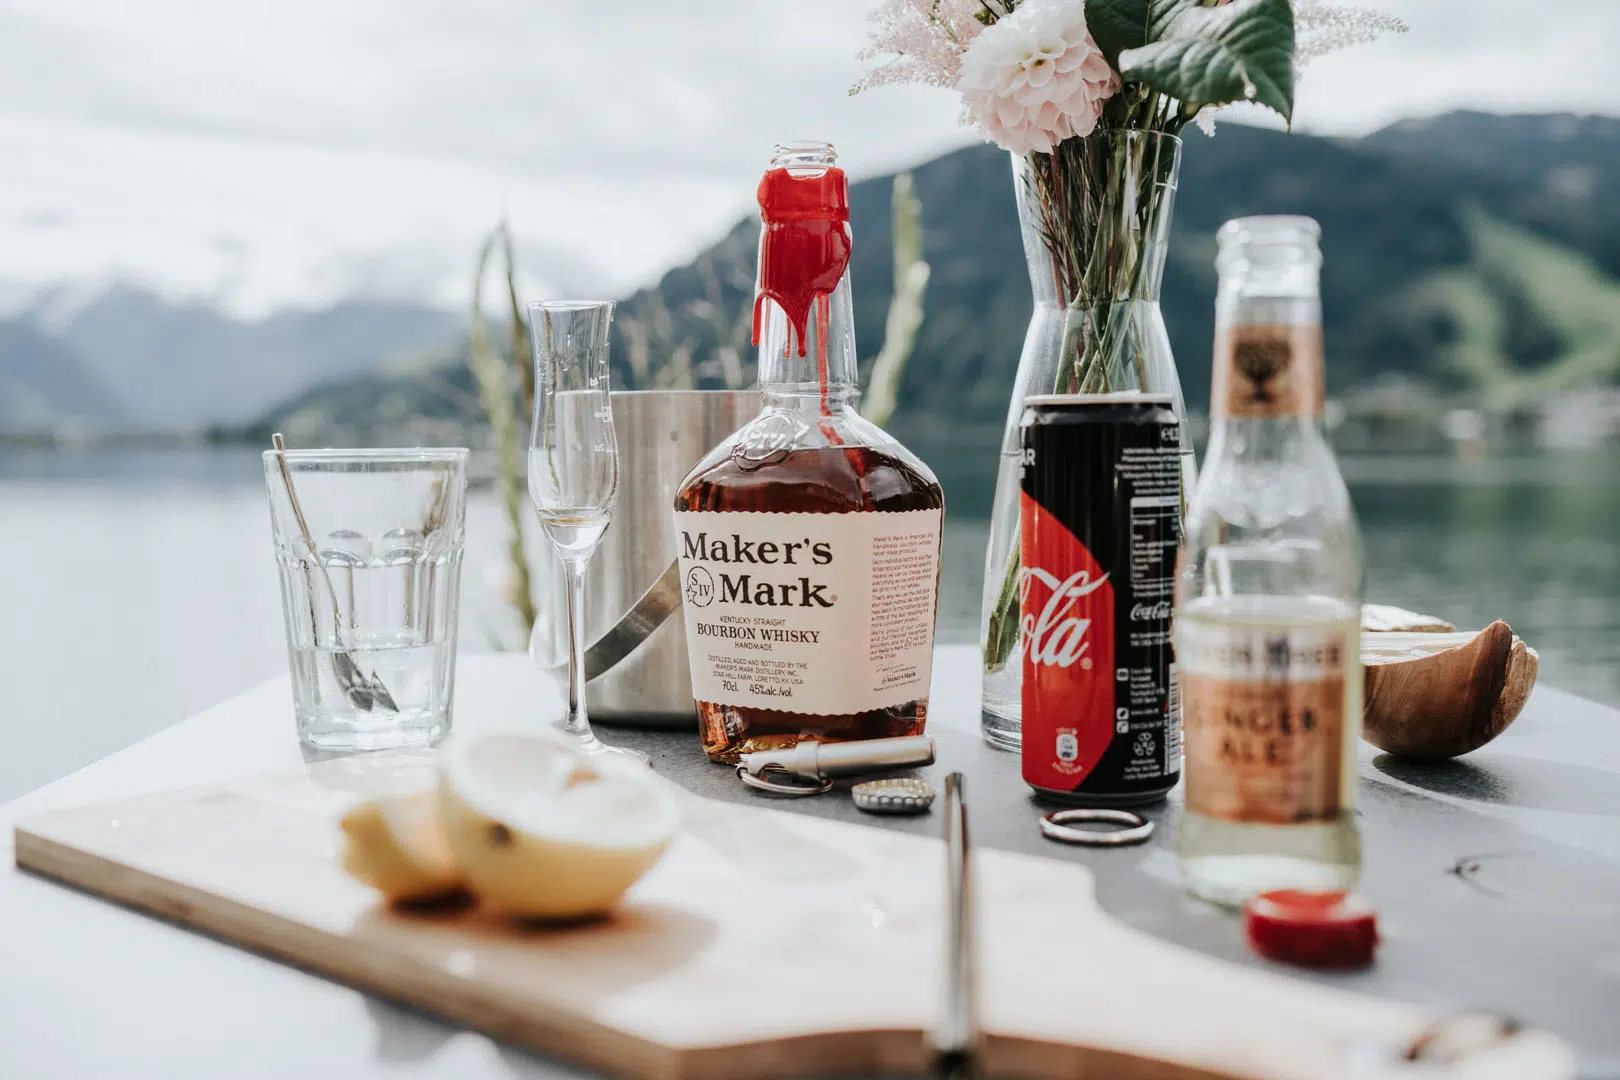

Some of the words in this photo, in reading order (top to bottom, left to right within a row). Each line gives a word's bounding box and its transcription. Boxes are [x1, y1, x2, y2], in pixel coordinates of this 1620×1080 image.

[682, 531, 833, 565] Maker's
[719, 573, 834, 607] Mark
[720, 615, 751, 625] KENTUCKY
[753, 618, 786, 627] STRAIGHT
[697, 622, 756, 640] BOURBON
[760, 628, 820, 643] WHISKY
[734, 641, 772, 651] HANDMADE
[761, 660, 785, 668] BOTTLED
